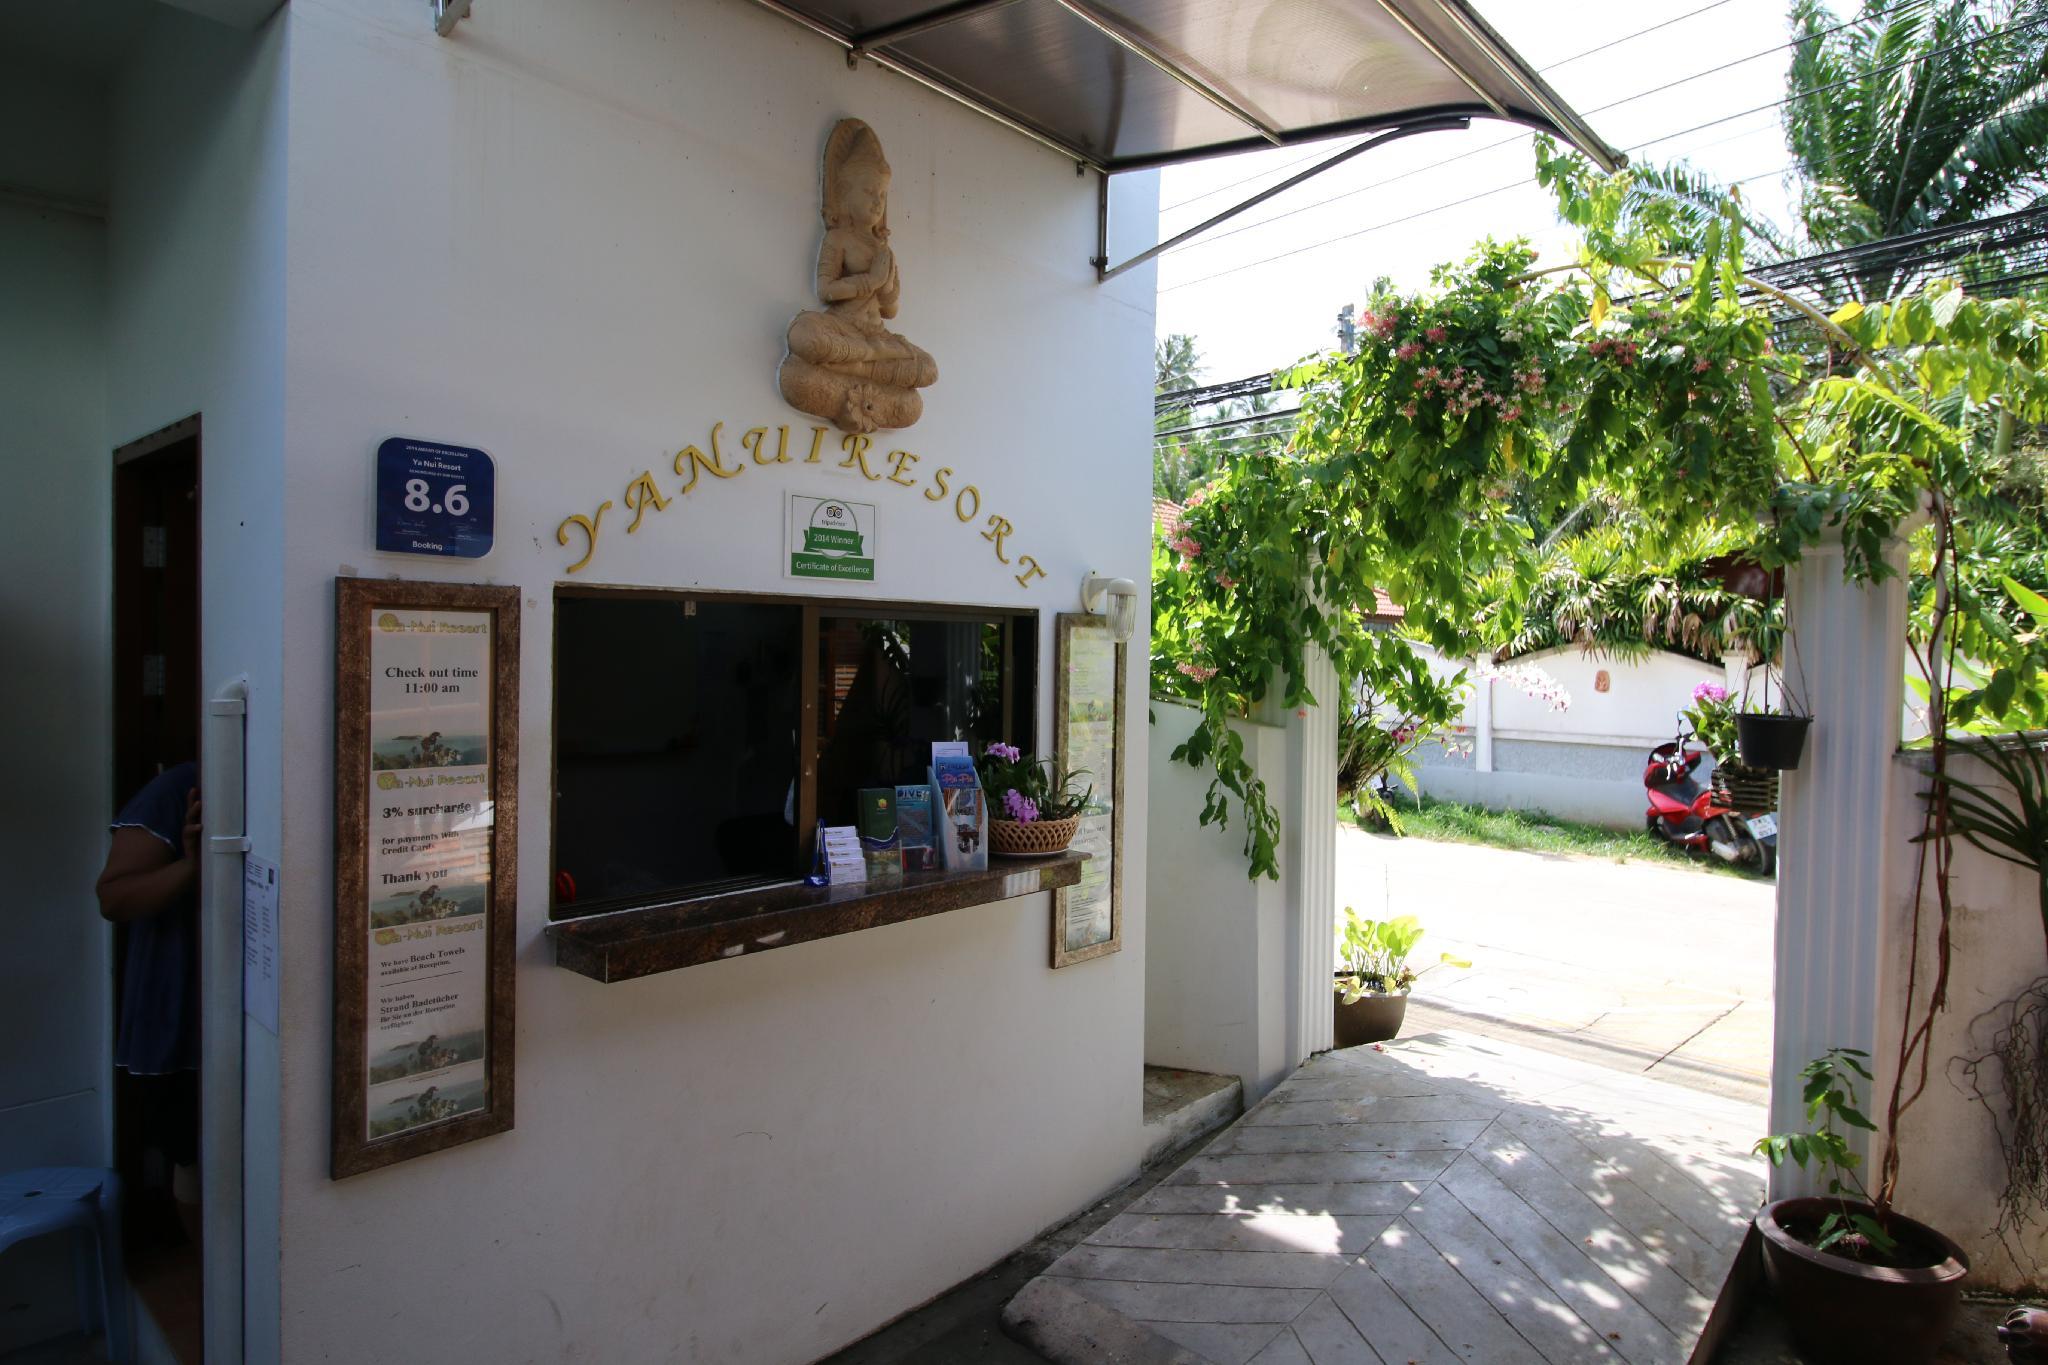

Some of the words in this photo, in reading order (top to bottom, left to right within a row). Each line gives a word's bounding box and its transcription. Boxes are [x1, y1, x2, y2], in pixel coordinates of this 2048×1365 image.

[412, 458, 422, 466] Ya
[423, 460, 437, 468] Nui
[438, 462, 461, 471] Resort
[404, 478, 470, 516] 8.6
[814, 534, 830, 543] 2014
[831, 535, 854, 545] Winner
[796, 561, 830, 570] Certificate
[838, 564, 870, 574] Excellence
[438, 622, 488, 634] Resort
[385, 667, 425, 678] Check
[430, 668, 448, 678] out
[452, 667, 479, 678] time
[405, 683, 438, 693] 11:00
[441, 685, 460, 693] am
[437, 773, 485, 785] Resort
[382, 807, 403, 818] 3%
[407, 802, 472, 816] surcharge
[382, 837, 393, 845] for
[398, 833, 439, 844] payments
[382, 845, 408, 855] Credit
[381, 870, 422, 884] Thank
[425, 869, 448, 882] you
[436, 919, 483, 936] Resort
[410, 953, 435, 963] Beach
[438, 947, 465, 958] Towels
[380, 1003, 409, 1014] Strand
